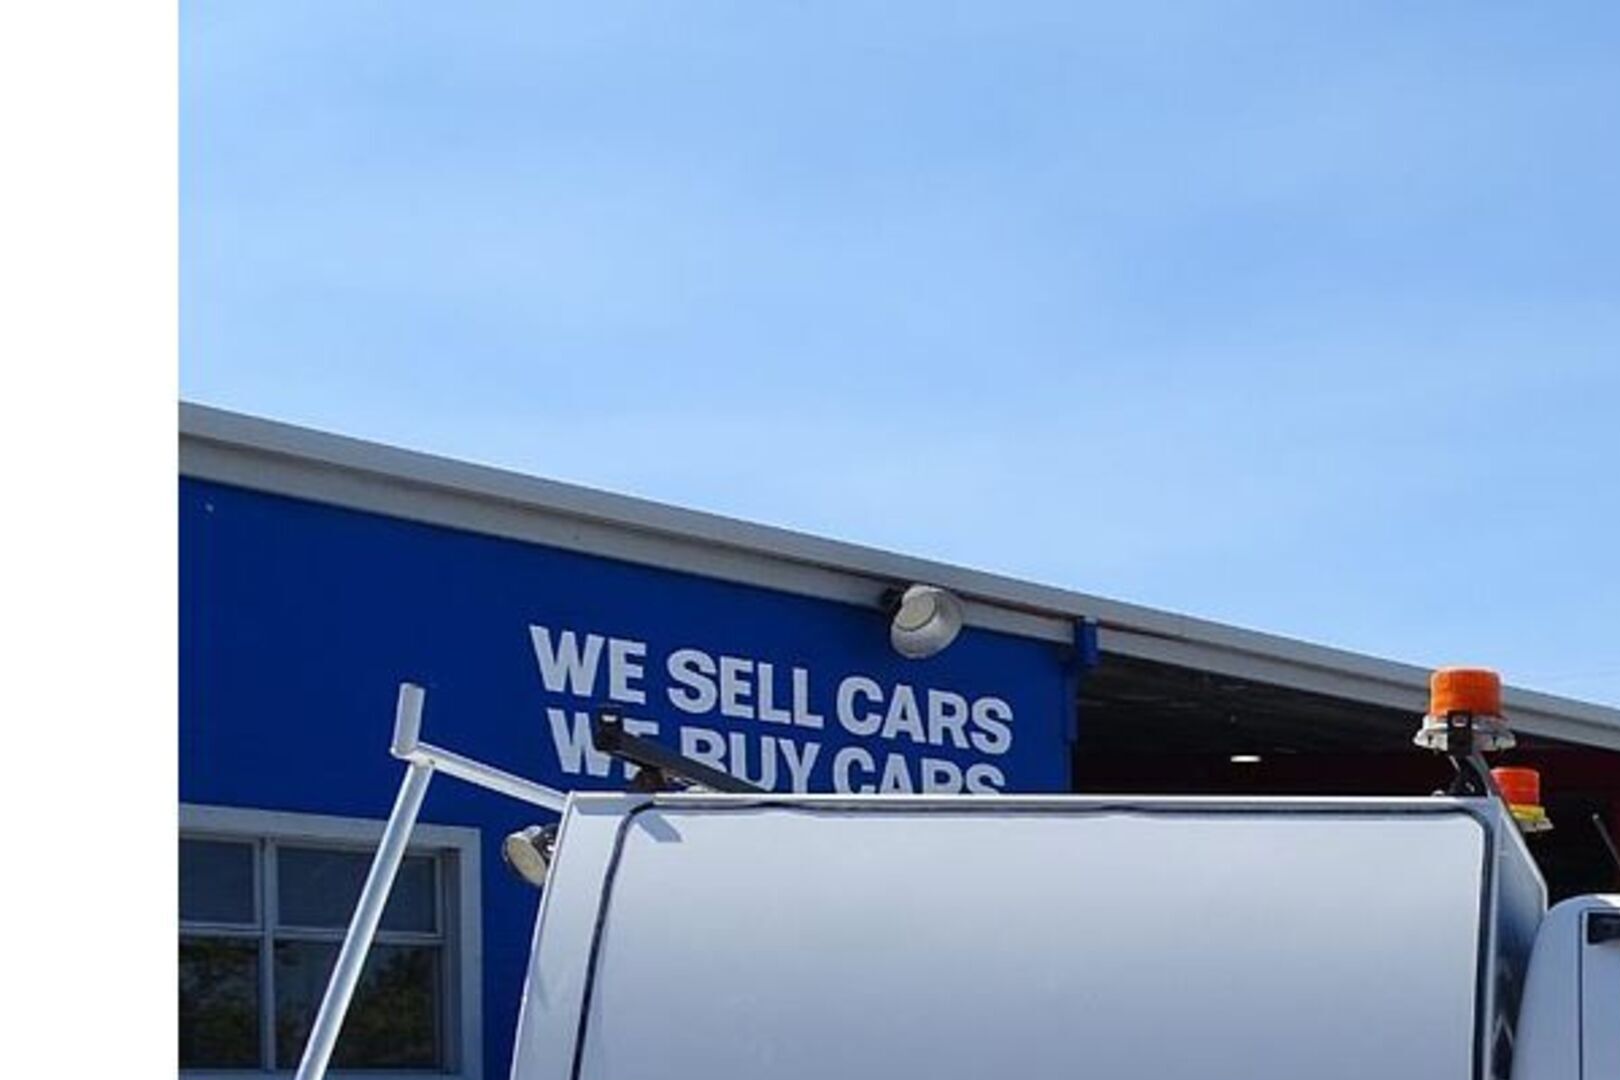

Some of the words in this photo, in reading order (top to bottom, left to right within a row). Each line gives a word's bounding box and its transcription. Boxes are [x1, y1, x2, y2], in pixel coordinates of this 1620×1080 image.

[529, 625, 647, 704] WE
[666, 649, 824, 729] SELL
[836, 676, 1014, 755] CARS
[680, 726, 822, 793] BUY
[833, 747, 1006, 795] CARS
